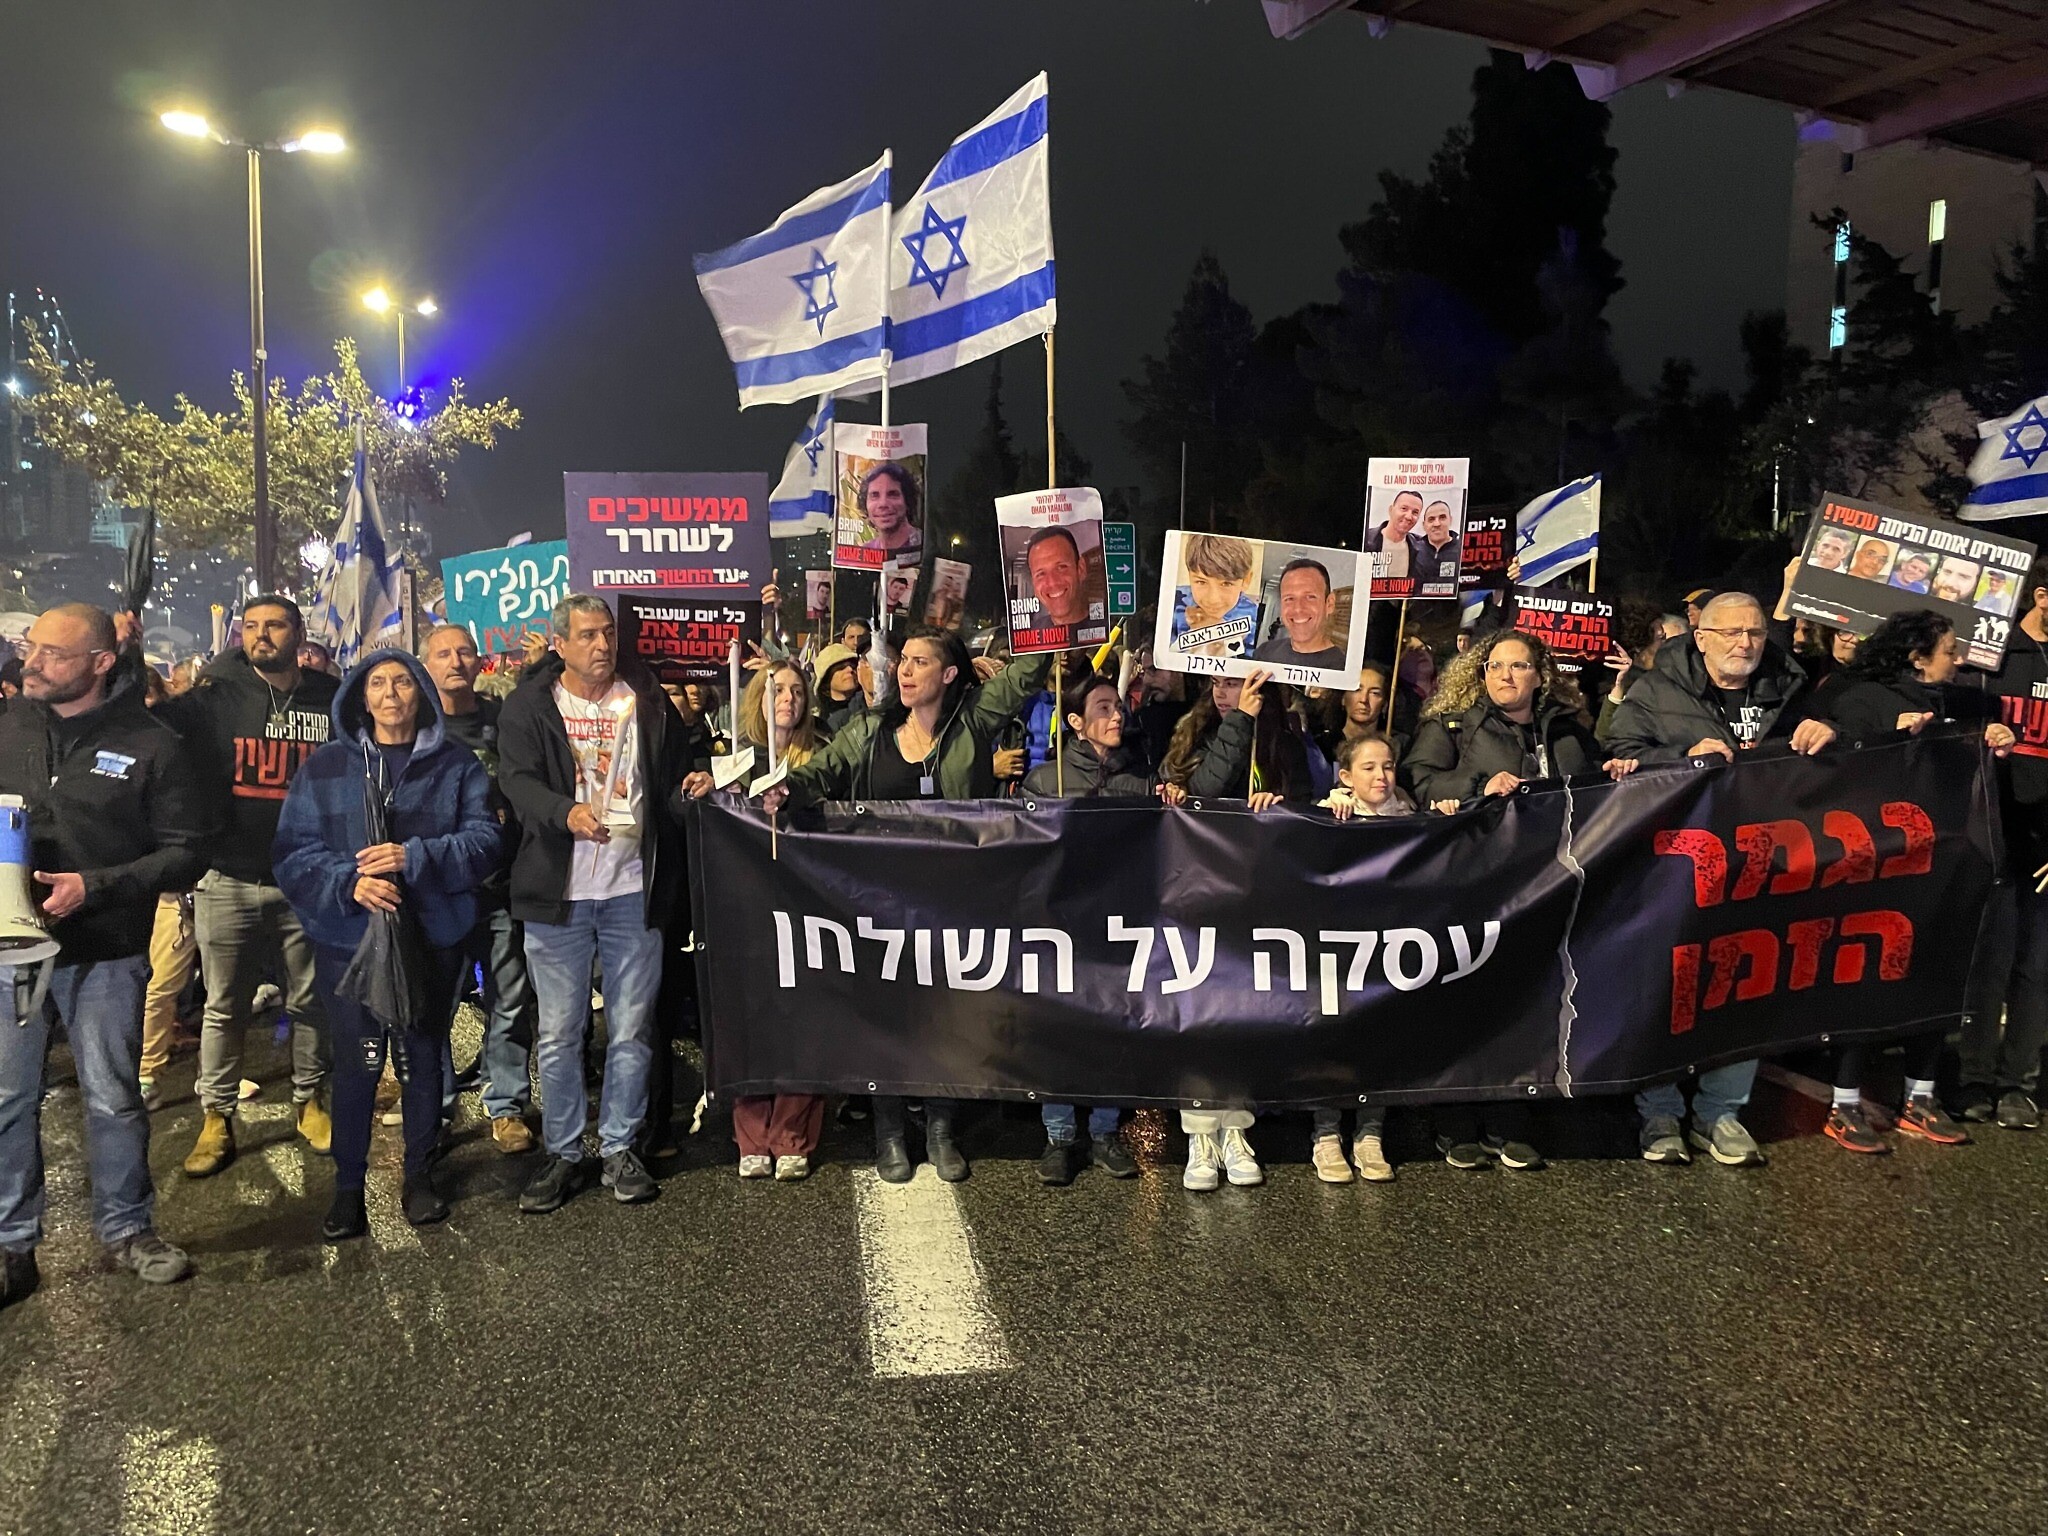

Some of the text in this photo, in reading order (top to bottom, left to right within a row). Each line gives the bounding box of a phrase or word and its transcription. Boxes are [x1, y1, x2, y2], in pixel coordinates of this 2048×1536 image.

[1383, 475, 1454, 485] ELI AND YOSSI SHARABI
[588, 497, 748, 522] ממשיכים
[1031, 505, 1047, 515] OHAD
[838, 517, 864, 533] BRING
[1467, 516, 1506, 532] כל יום
[1877, 516, 1929, 545] הביתה
[605, 523, 734, 553] לשחרר
[837, 530, 855, 546] HIM
[1927, 529, 1971, 556] אותם
[836, 545, 861, 561] HOME
[863, 548, 888, 563] NOW!
[1970, 540, 2032, 571] מחזירים
[455, 554, 570, 602] תחזירו
[1371, 564, 1389, 578] HEM
[1371, 579, 1388, 593] OME
[1389, 578, 1415, 593] NOW!
[498, 581, 571, 623] ותם
[1010, 597, 1040, 615] BRING
[1514, 594, 1613, 617] כל יום שעובר
[632, 605, 746, 624] כל יום שעובר
[1012, 613, 1031, 630] HIM
[1516, 609, 1608, 634] הורג את
[639, 621, 740, 640] הורג את
[1013, 629, 1041, 647] HOME
[1042, 624, 1070, 644] NOW!
[1181, 620, 1248, 646] מחכה לאבא
[1186, 655, 1226, 672] איתן
[1283, 667, 1321, 683] אוהד
[288, 710, 329, 729] מחזירים
[303, 726, 329, 742] אותם
[1653, 801, 1936, 908] נגמר
[772, 910, 1502, 1016] עסקה על השולחן
[1670, 910, 1914, 1035] הזמן
